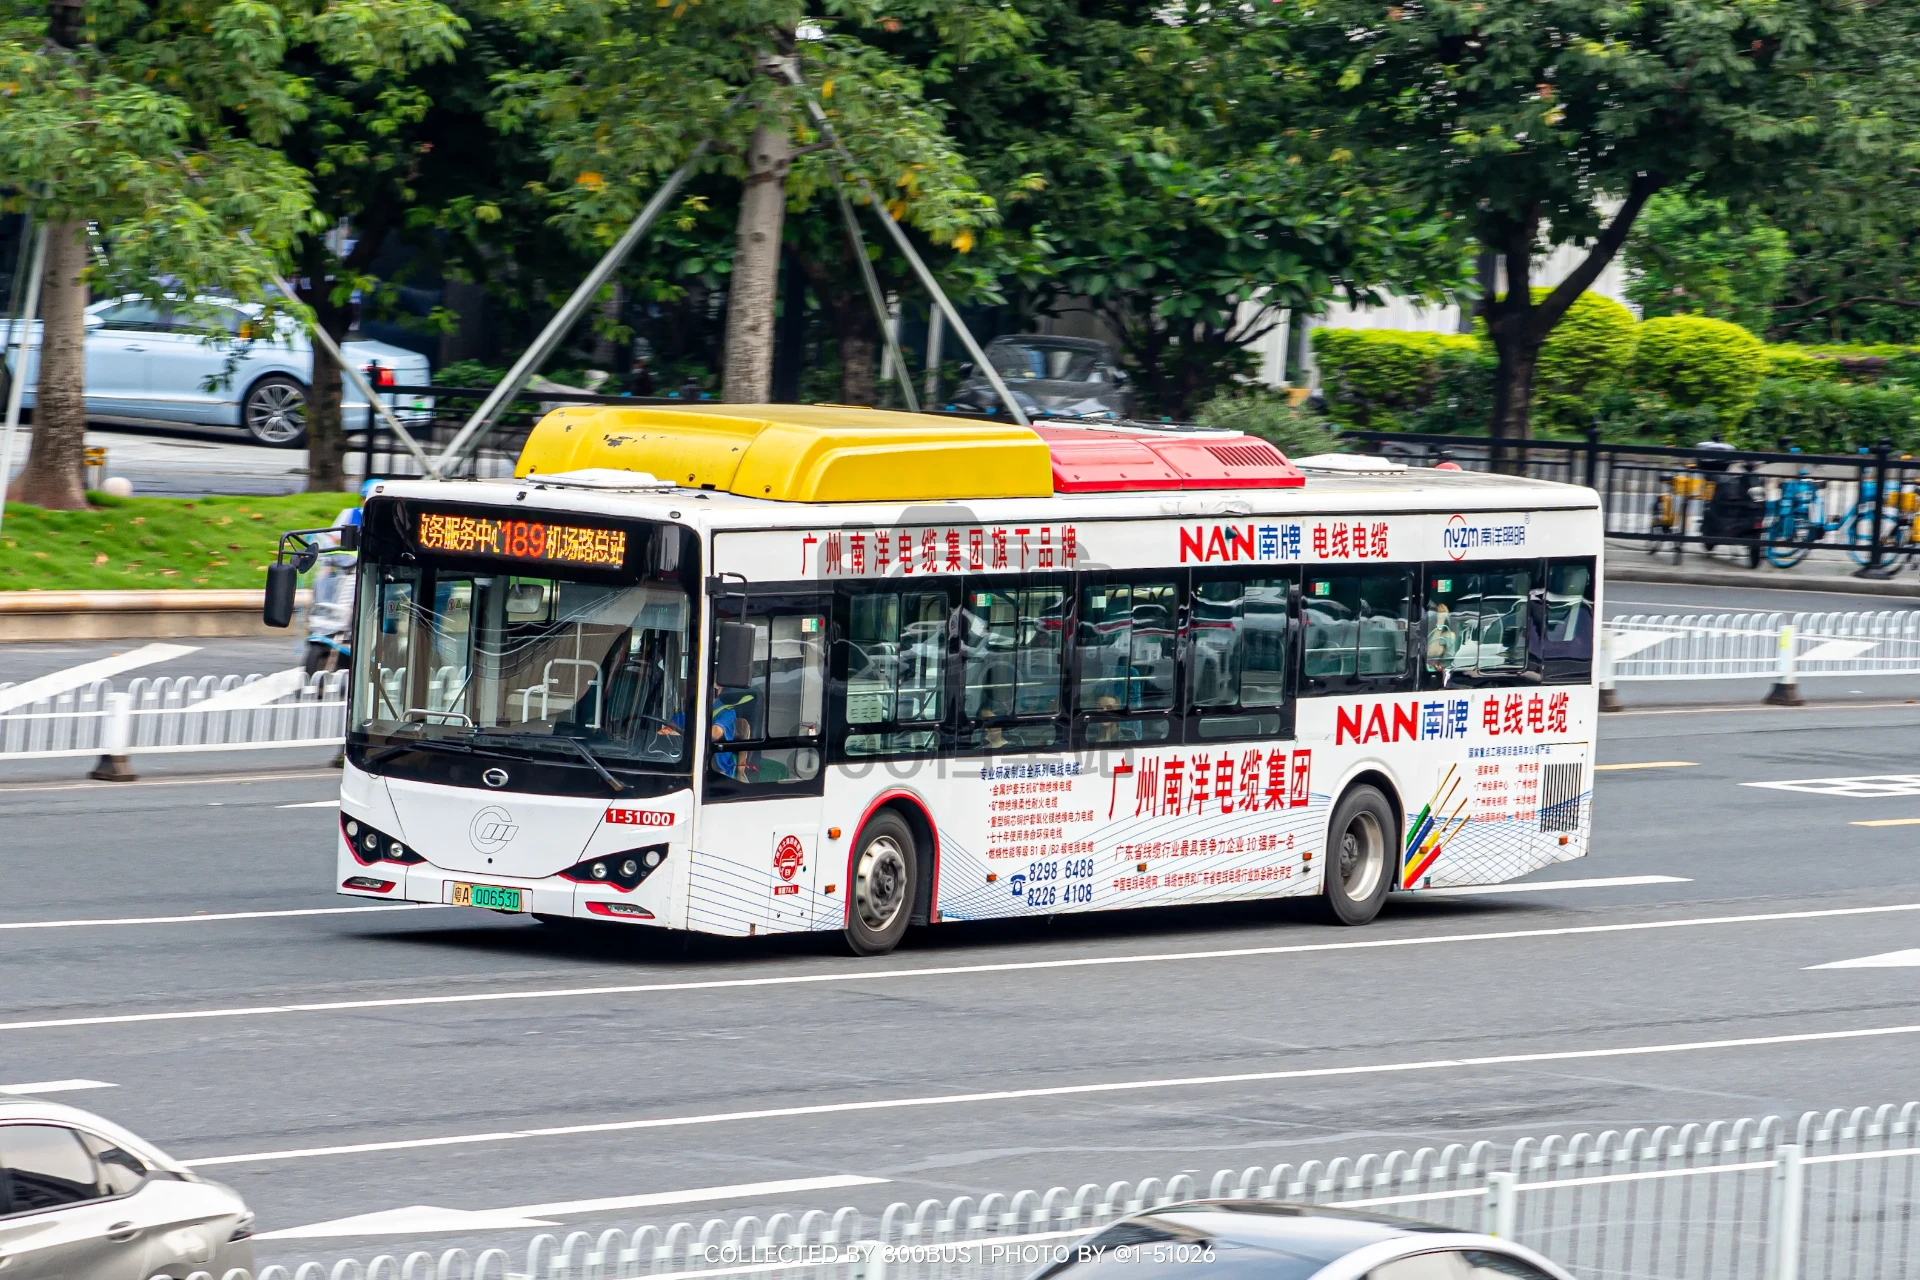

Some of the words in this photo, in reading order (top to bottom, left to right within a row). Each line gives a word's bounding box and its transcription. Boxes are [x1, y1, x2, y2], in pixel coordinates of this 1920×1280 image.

[501, 520, 545, 558] 189
[545, 524, 626, 565] 机场路总站
[801, 524, 1077, 576] 广州南洋电缆集团旗下品牌
[1180, 524, 1255, 563] NAN
[1258, 524, 1301, 561] 南牌
[1312, 522, 1389, 560] 电线电缆
[1480, 525, 1526, 547] 南洋照明
[1335, 701, 1419, 746] NAN
[1421, 699, 1470, 742] 南牌
[1482, 691, 1570, 736] 电线电缆
[1108, 748, 1312, 821] 广州南洋电缆集团
[610, 809, 671, 826] 1-51000
[1029, 861, 1058, 882] 8298
[1065, 858, 1094, 879] 6488
[475, 888, 520, 908] 00653D
[1027, 886, 1056, 907] 8226
[1064, 884, 1092, 904] 4108
